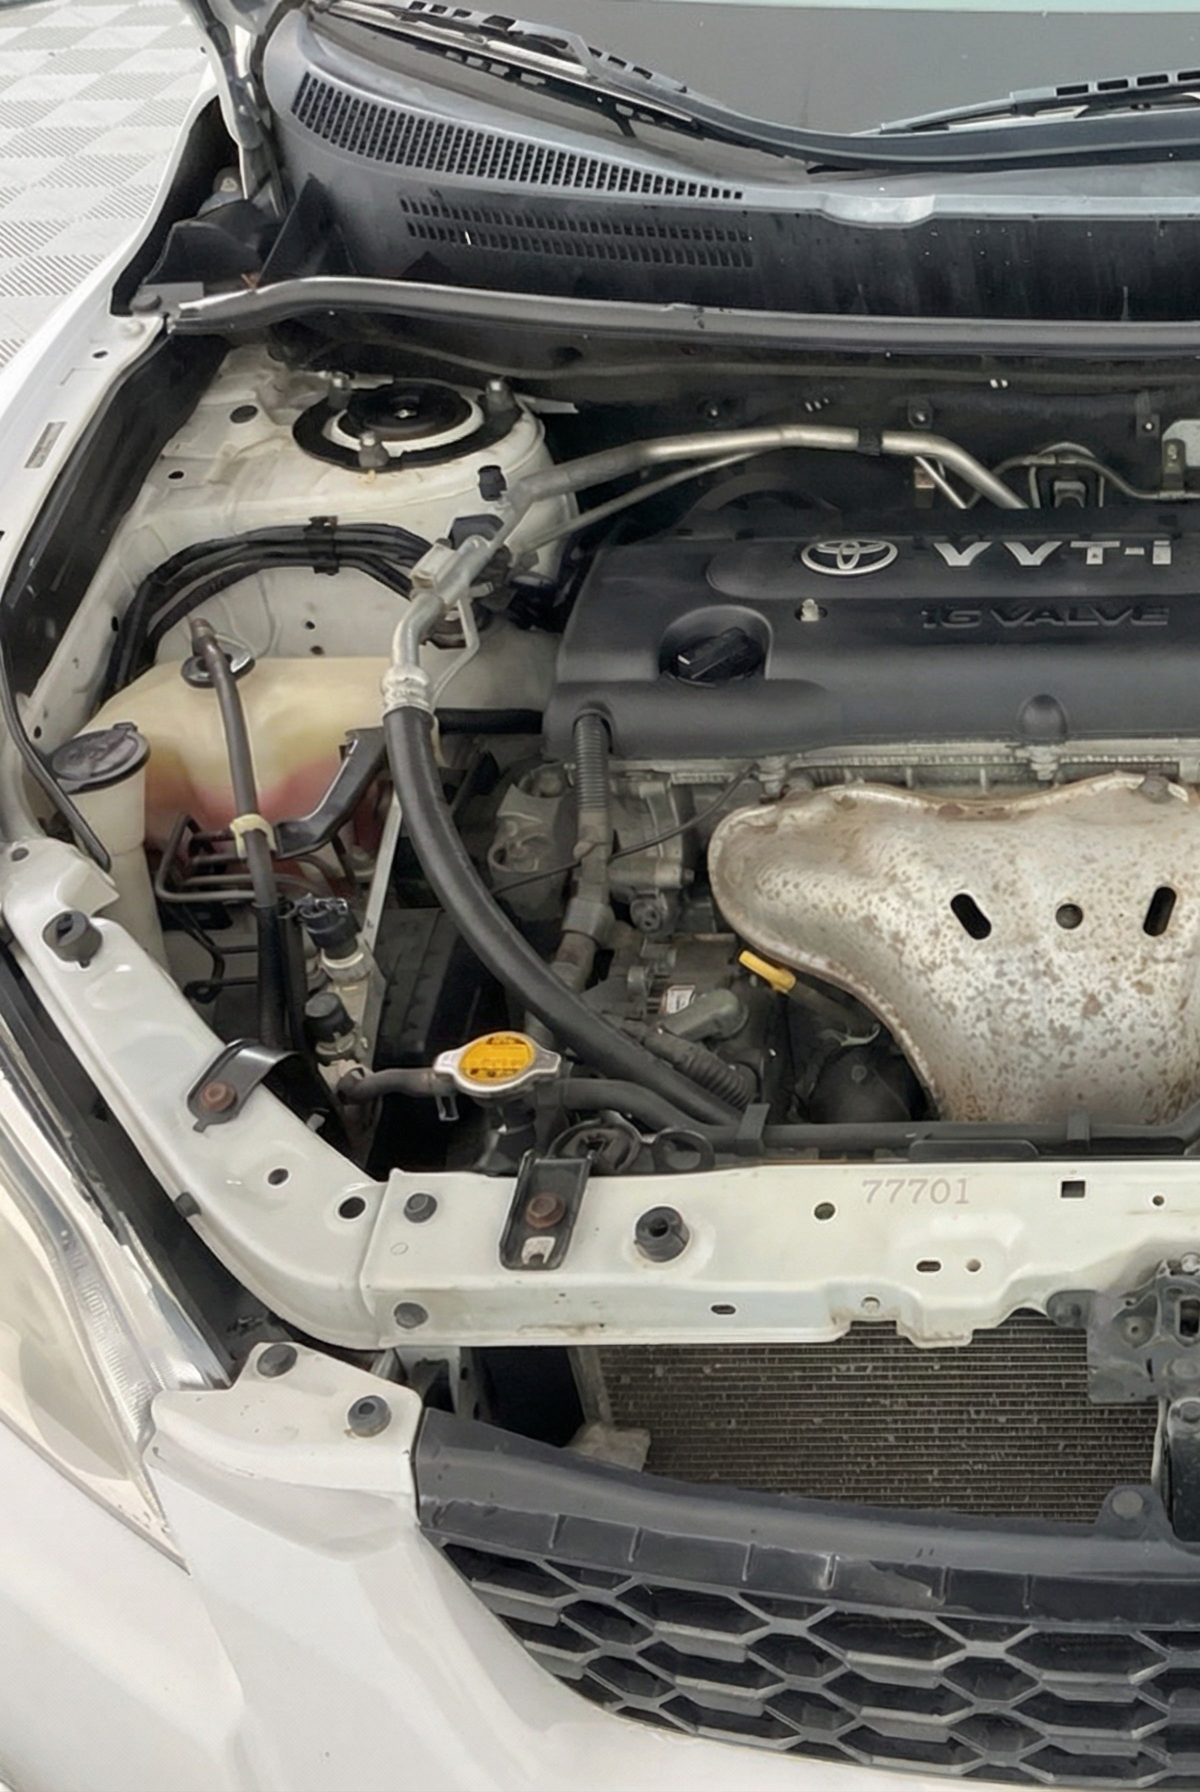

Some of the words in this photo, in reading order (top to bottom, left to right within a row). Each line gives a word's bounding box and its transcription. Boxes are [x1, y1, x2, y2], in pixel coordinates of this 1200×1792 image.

[933, 541, 1172, 567] VVT-i
[921, 607, 982, 629] 16
[990, 605, 1170, 628] VALVE
[861, 1177, 970, 1205] 77701
